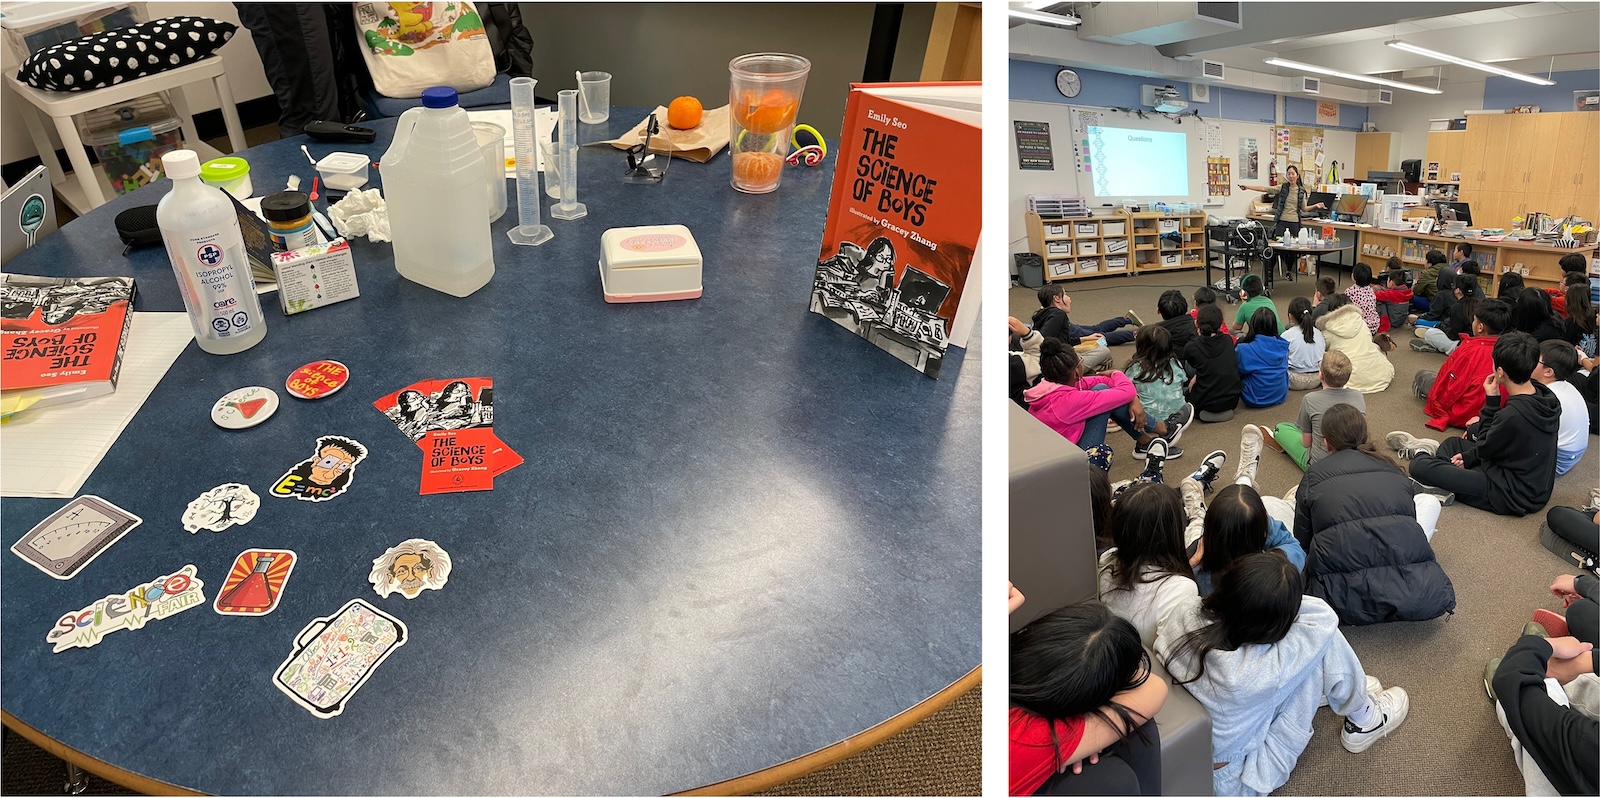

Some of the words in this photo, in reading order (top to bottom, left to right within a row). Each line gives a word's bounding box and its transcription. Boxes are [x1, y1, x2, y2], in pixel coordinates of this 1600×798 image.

[867, 109, 891, 127] Emily
[891, 117, 908, 130] Seo
[862, 127, 899, 160] THE
[1127, 134, 1153, 143] Questions
[852, 178, 875, 203] OF
[881, 218, 910, 239] Gracey
[910, 232, 938, 251] Zhang
[203, 251, 218, 259] PSP
[195, 264, 234, 278] ISOPROPYL
[200, 272, 234, 285] ALCOHOL
[212, 282, 227, 290] 99%
[72, 332, 97, 345] OF
[49, 355, 91, 370] THE
[316, 362, 345, 376] THE
[59, 369, 87, 377] Emily
[289, 378, 320, 397] BOYS
[432, 437, 457, 447] THE
[431, 456, 446, 467] OF
[157, 590, 201, 616] FAIR
